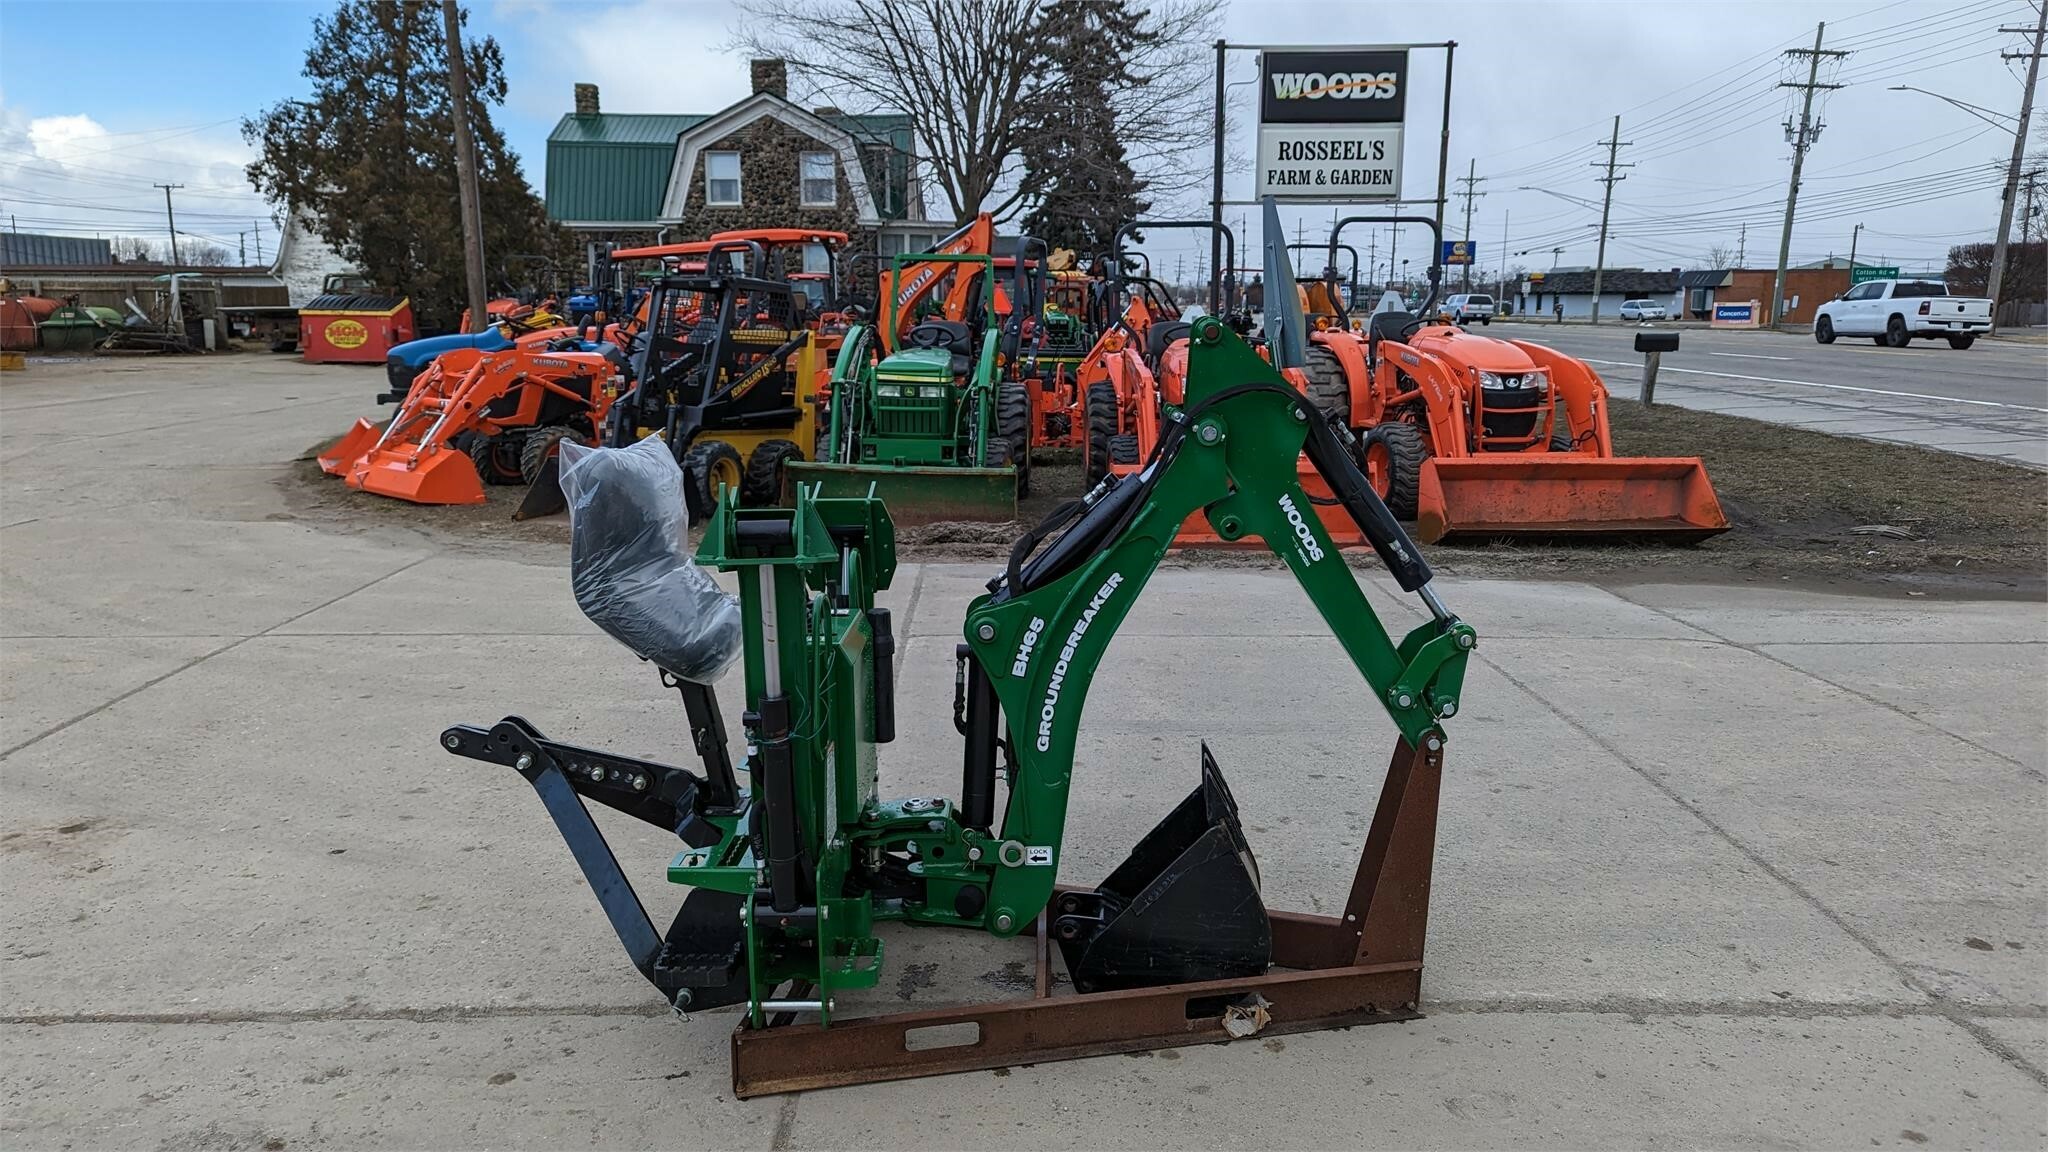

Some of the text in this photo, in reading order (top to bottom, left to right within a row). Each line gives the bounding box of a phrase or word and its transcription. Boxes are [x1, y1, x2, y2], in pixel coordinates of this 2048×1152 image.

[1271, 72, 1397, 99] WOODS
[1277, 140, 1385, 161] ROSSEEL'S
[1267, 169, 1394, 185] FARM & GARDEN
[897, 267, 934, 309] UBOTA
[532, 358, 568, 369] KUBOTA
[1278, 493, 1325, 562] WOODS
[1011, 616, 1045, 678] BH65
[1036, 572, 1125, 752] GROUNDBREAKER
